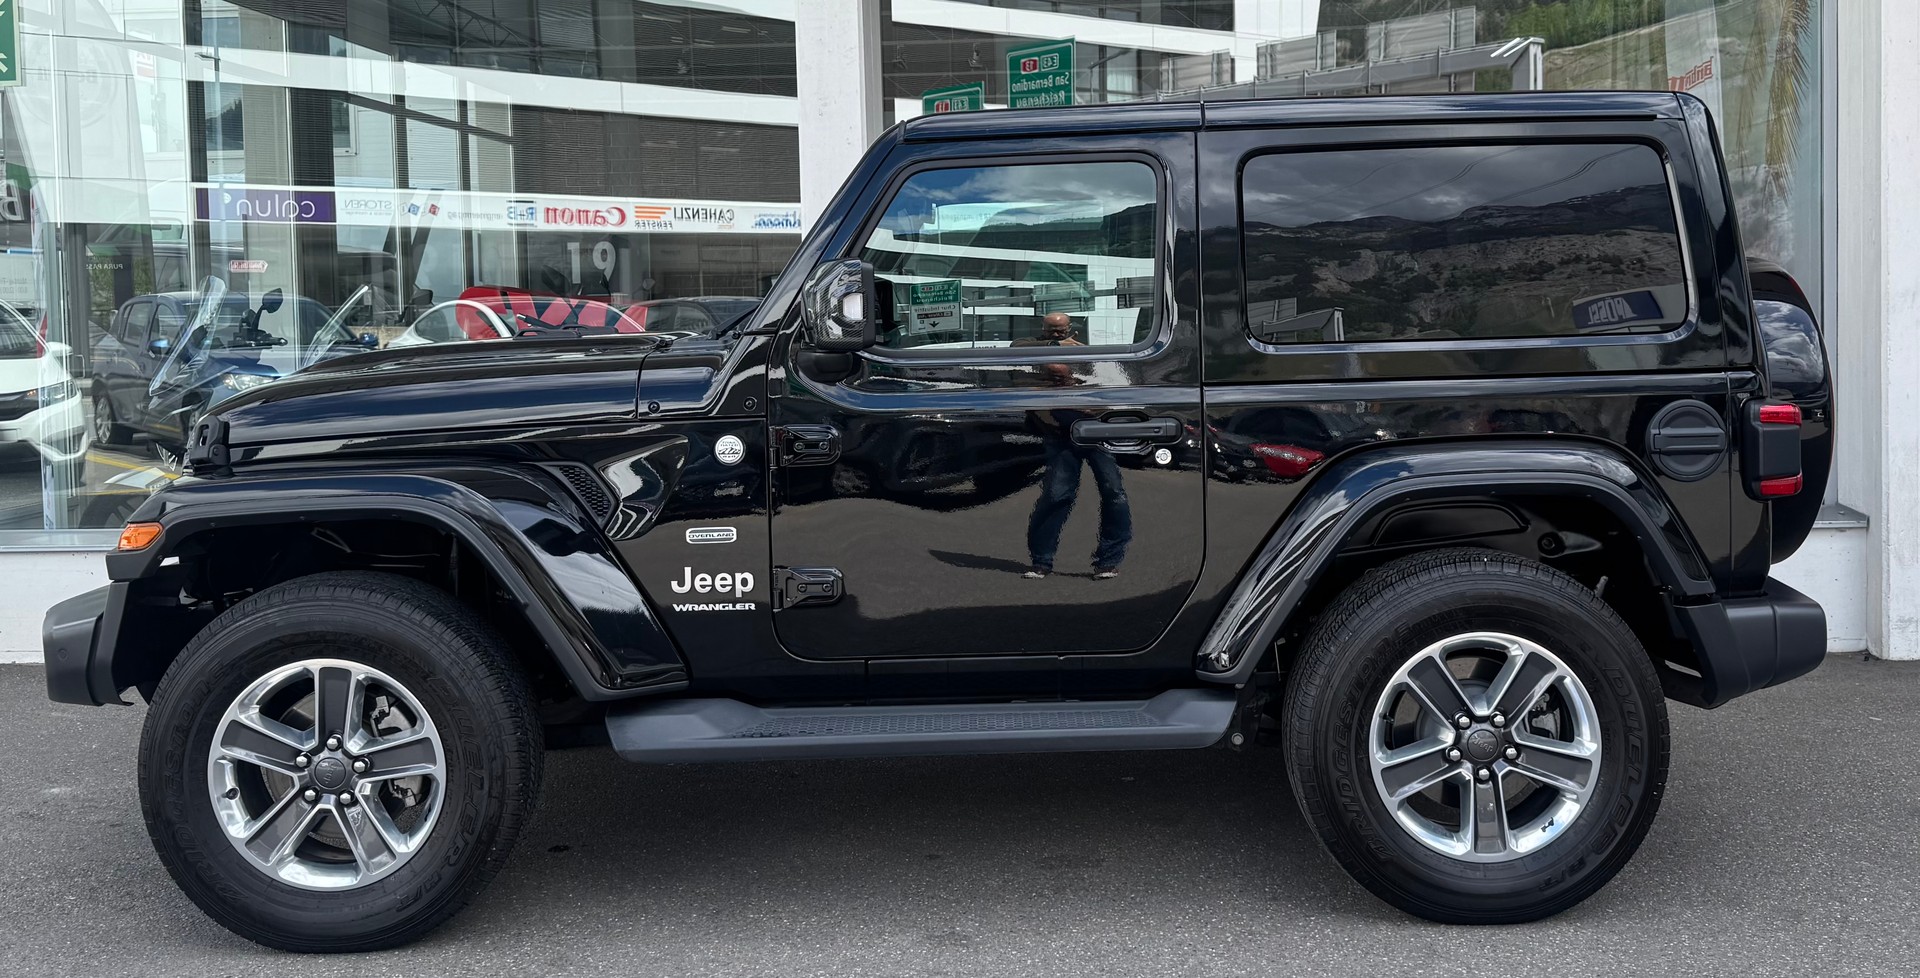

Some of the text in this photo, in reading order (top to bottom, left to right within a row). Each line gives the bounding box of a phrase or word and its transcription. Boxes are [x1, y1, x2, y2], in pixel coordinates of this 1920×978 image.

[566, 240, 617, 284] 19
[688, 532, 735, 540] OVERLAND
[670, 566, 755, 598] Jeep
[672, 602, 756, 612] WRANGLER
